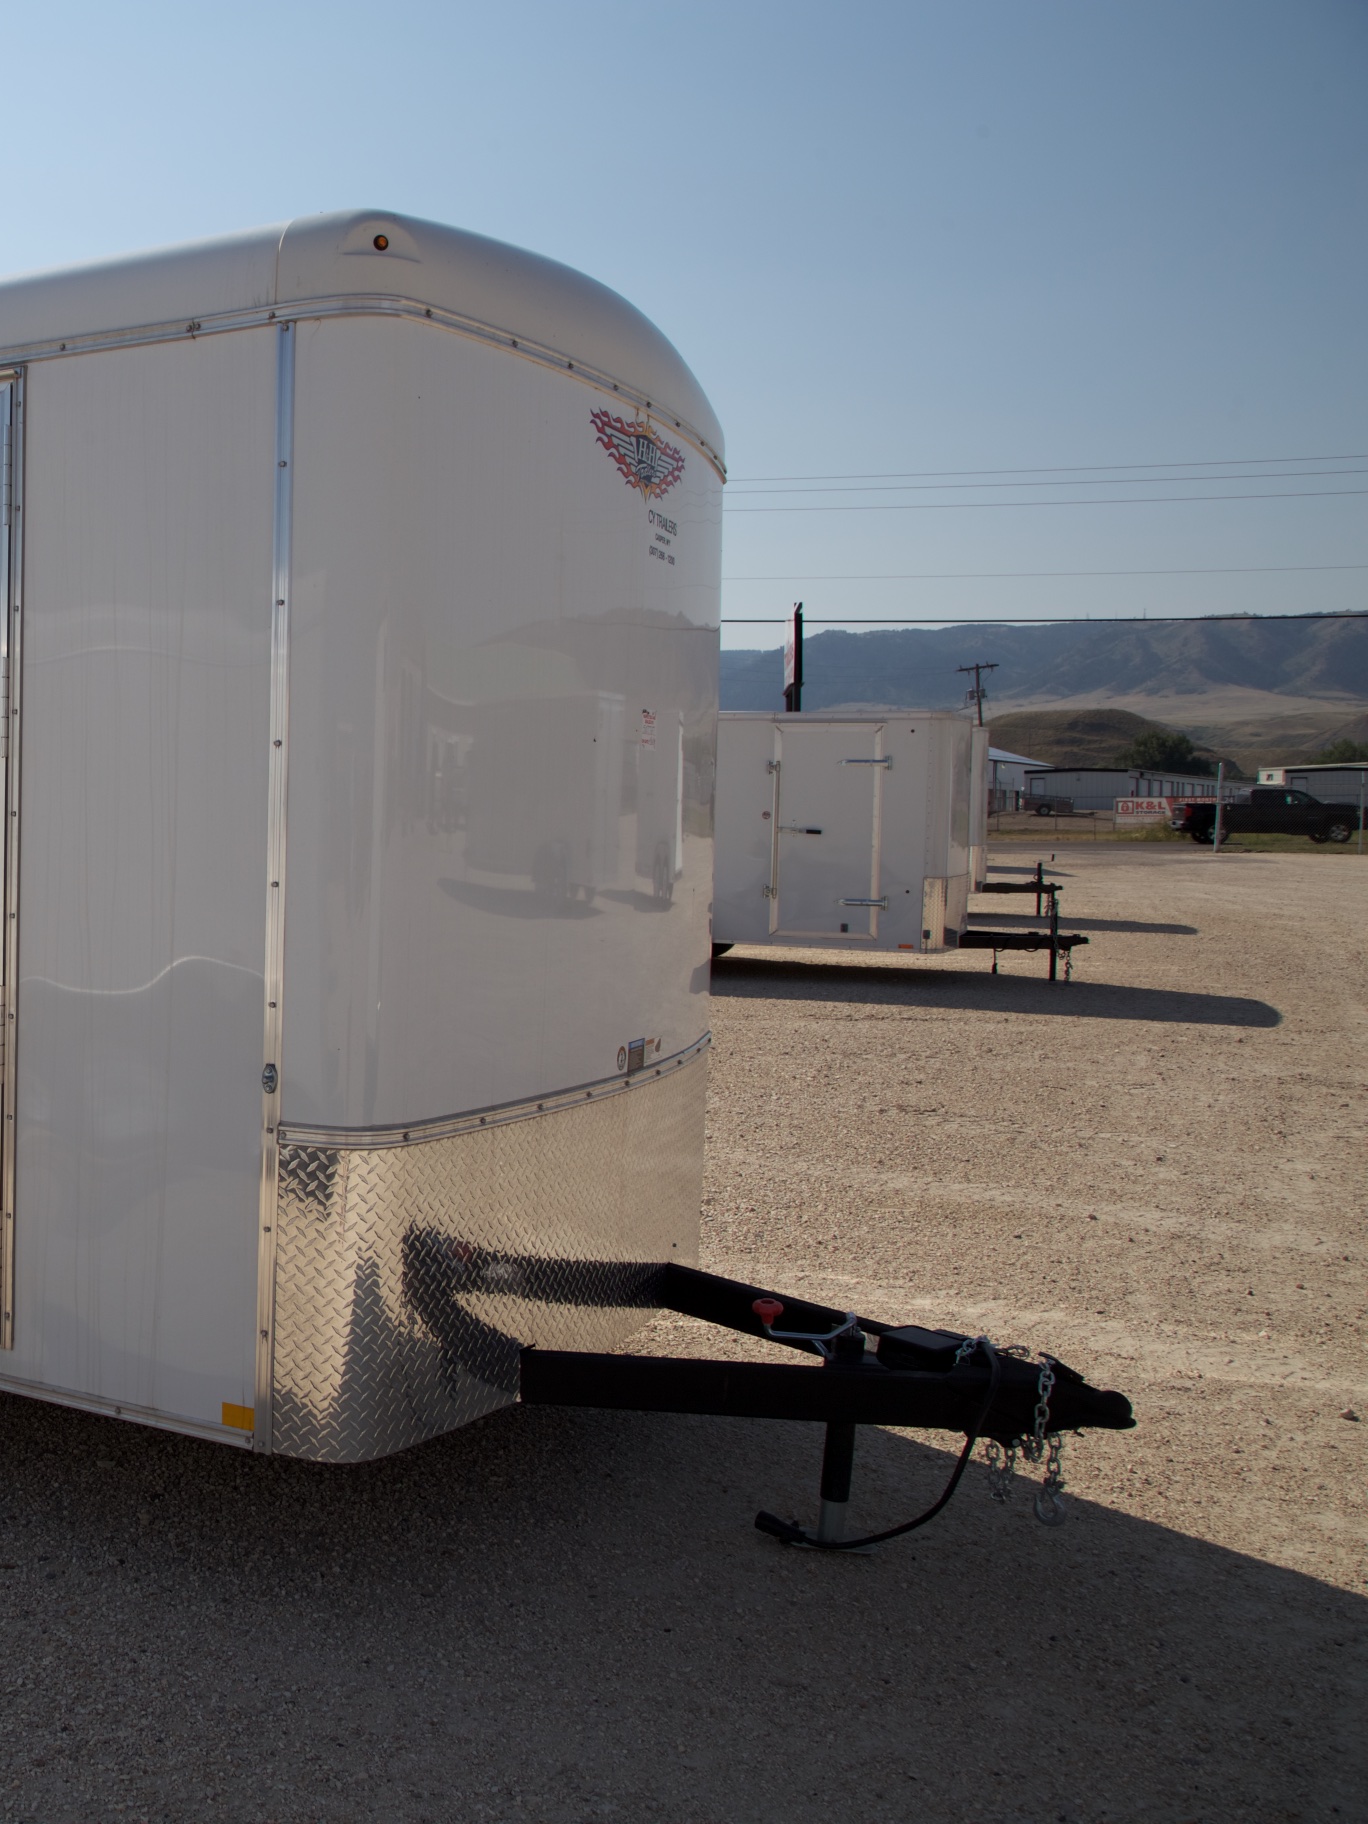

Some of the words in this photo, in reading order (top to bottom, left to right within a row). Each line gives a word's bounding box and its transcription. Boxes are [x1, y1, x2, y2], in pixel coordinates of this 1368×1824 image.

[648, 509, 656, 525] CY
[655, 513, 678, 537] TRAILERS
[1135, 801, 1166, 810] K&L
